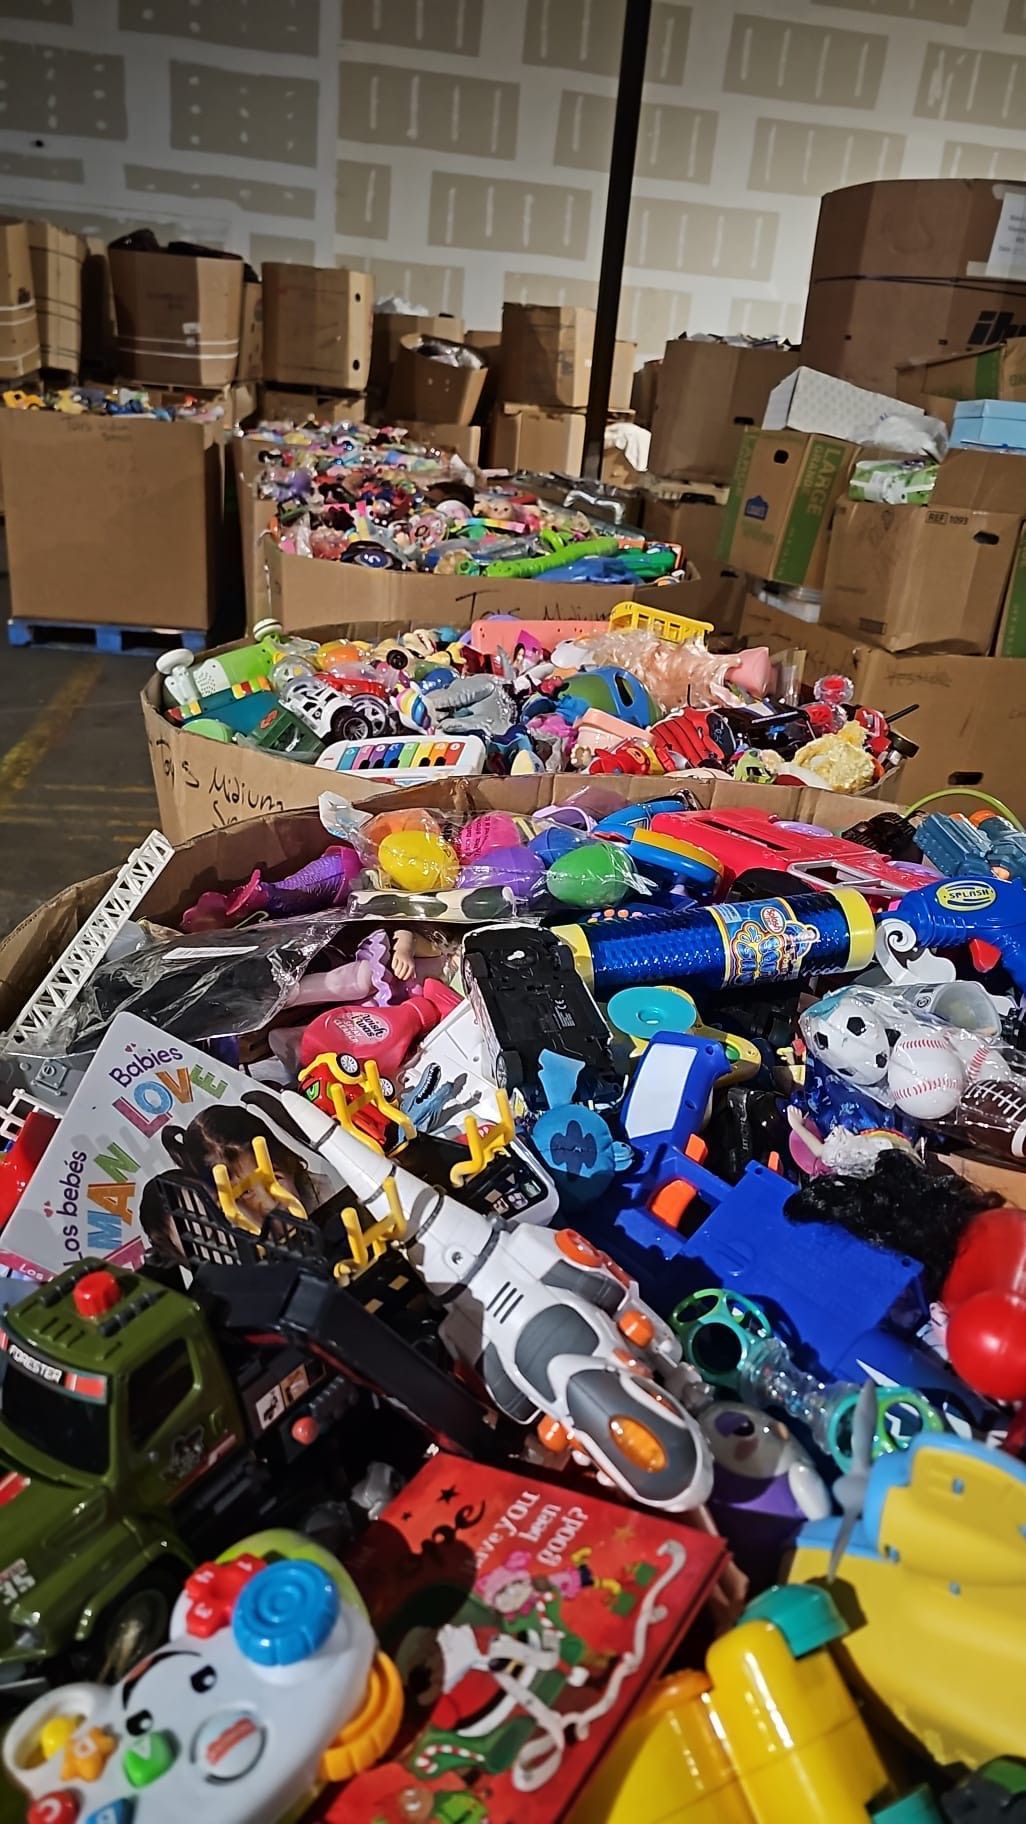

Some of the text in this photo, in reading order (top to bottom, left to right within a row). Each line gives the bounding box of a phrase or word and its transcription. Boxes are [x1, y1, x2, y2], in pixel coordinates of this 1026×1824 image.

[806, 447, 842, 516] LARGE
[928, 512, 969, 526] REF 1093
[948, 889, 990, 900] SPLASH
[108, 1047, 184, 1088] Babies
[112, 1064, 229, 1139] LOVE
[56, 1150, 88, 1217] bebés
[19, 1263, 45, 1281] Los
[9, 1344, 63, 1384] FORESTER
[494, 1491, 541, 1537] you
[517, 1504, 562, 1543] been
[536, 1506, 589, 1567] good?
